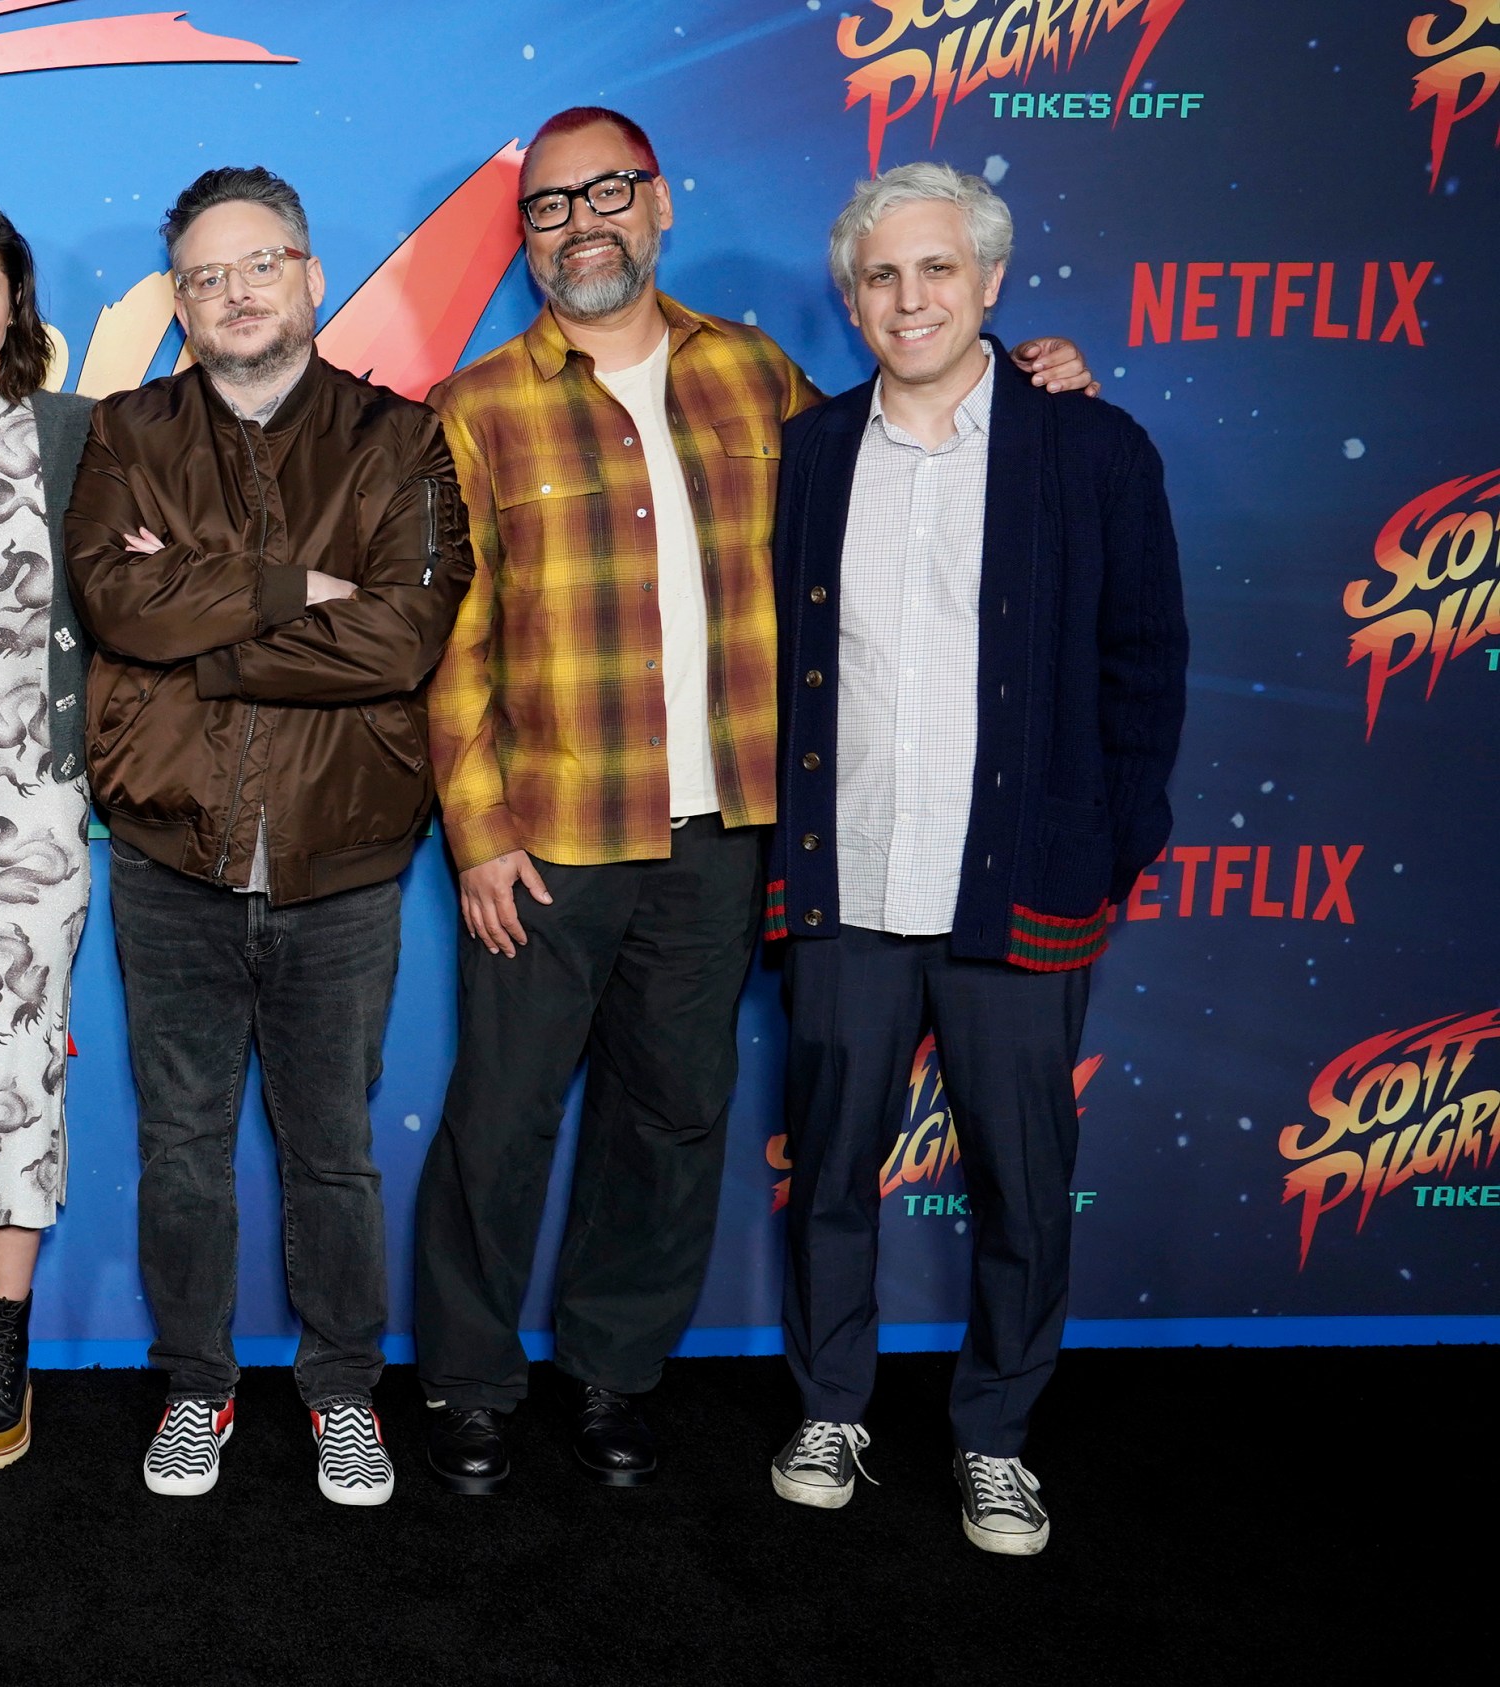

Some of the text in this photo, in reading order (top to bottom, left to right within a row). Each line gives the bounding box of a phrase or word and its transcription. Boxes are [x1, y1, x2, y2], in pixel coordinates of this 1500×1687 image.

[989, 92, 1204, 118] TAKES OFF
[1128, 261, 1435, 347] NETFLIX
[1343, 468, 1500, 619] SCO
[1107, 845, 1364, 924] ETFLIX
[1279, 1008, 1500, 1161] SCOTT
[903, 1194, 973, 1216] TAK
[1281, 1089, 1500, 1274] PILGR
[1413, 1185, 1500, 1207] TAKE
